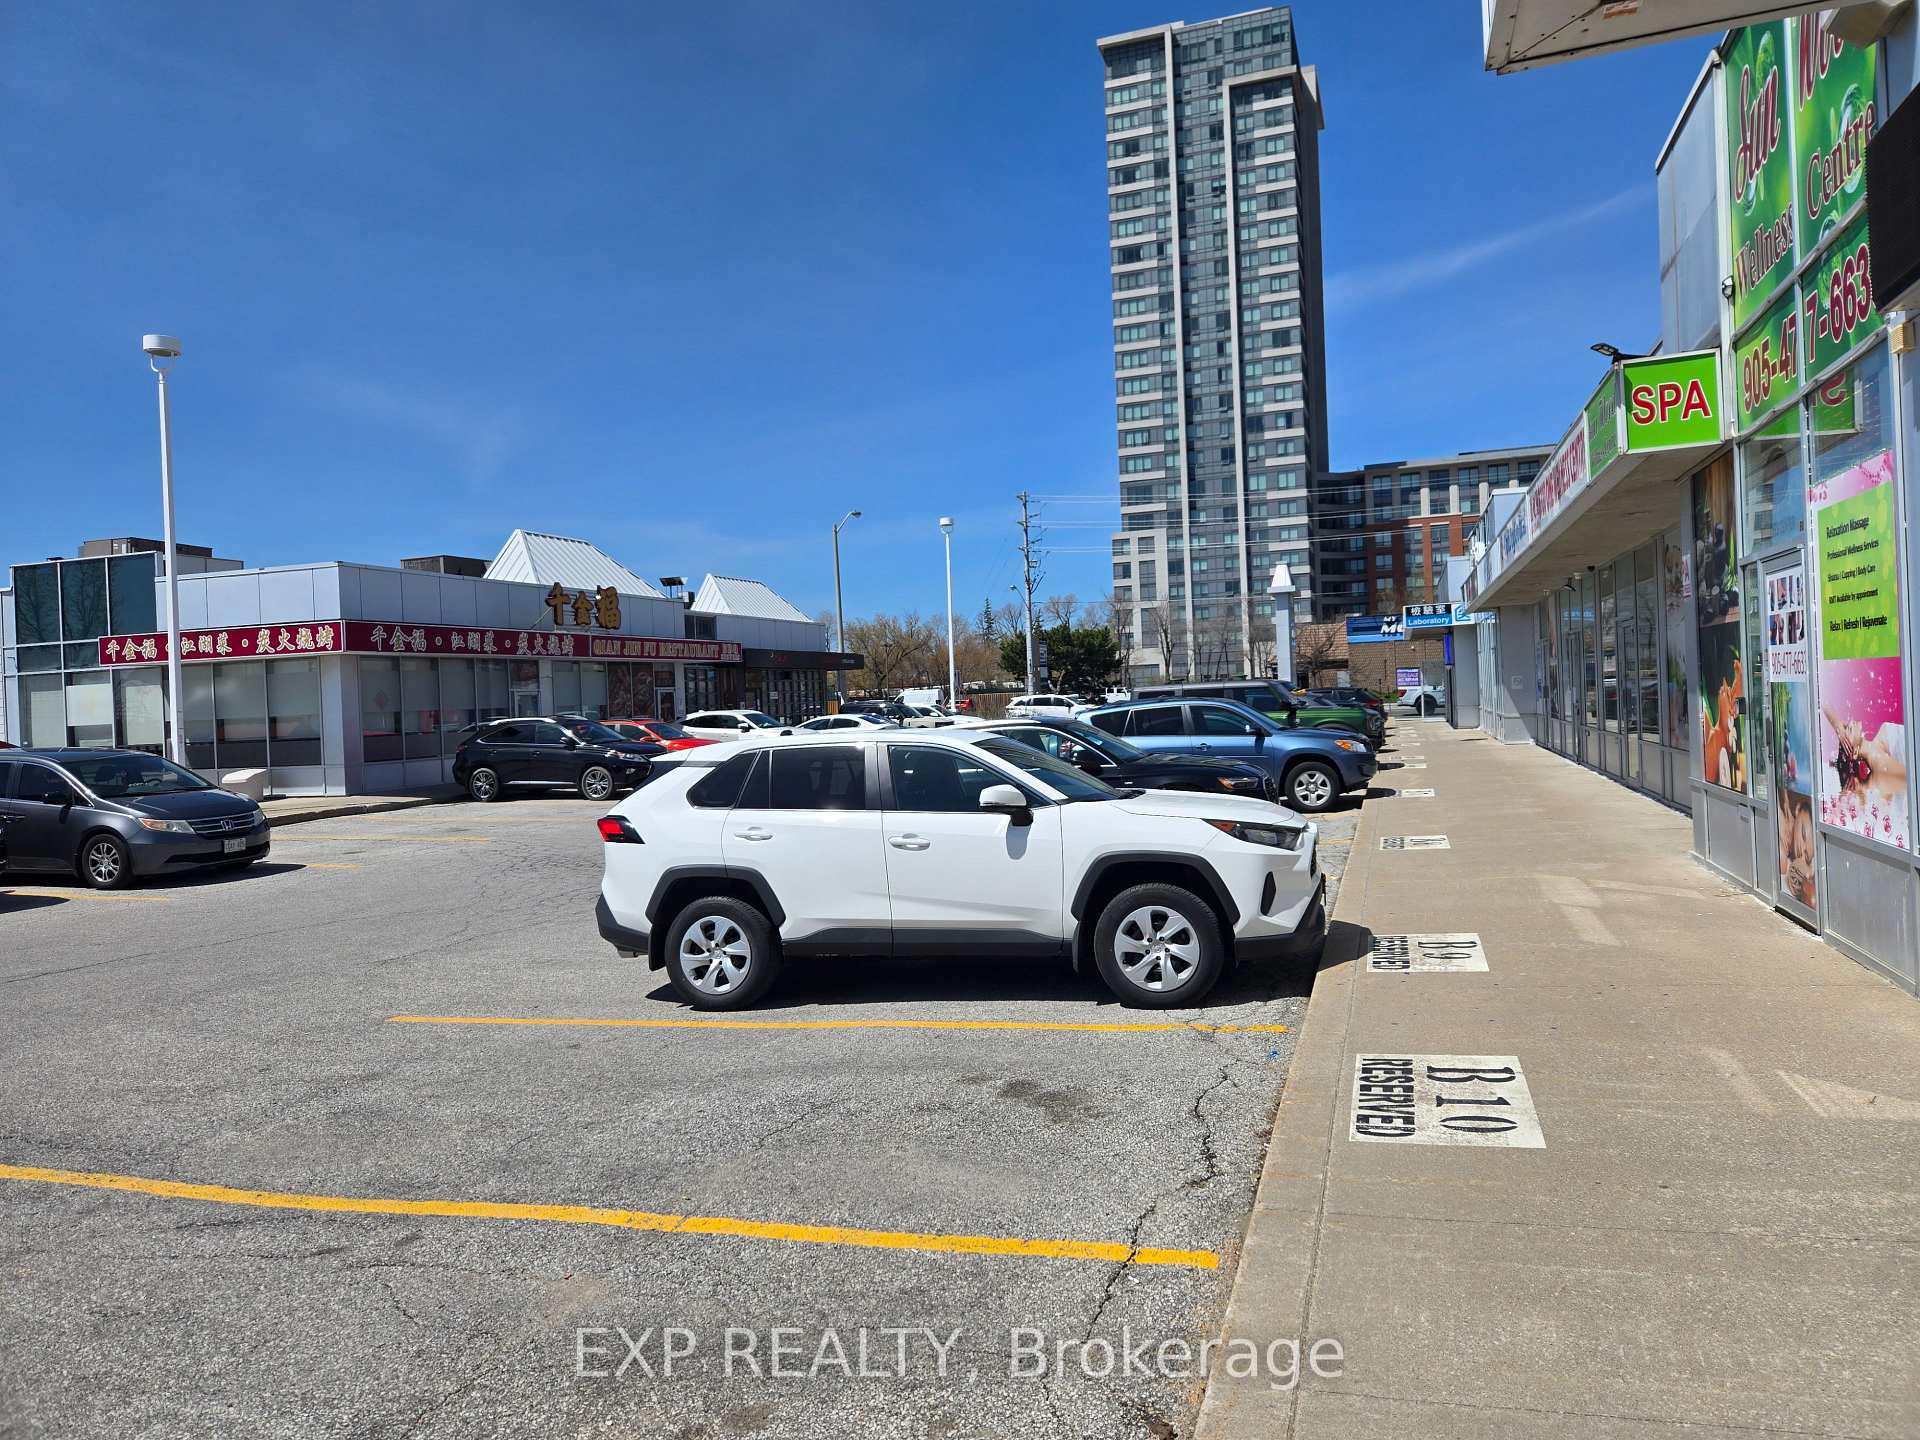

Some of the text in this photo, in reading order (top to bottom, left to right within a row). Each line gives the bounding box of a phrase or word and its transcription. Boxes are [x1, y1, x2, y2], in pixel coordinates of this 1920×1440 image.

[1735, 64, 1781, 203] Sun
[1735, 202, 1794, 304] Wellness
[1807, 101, 1877, 219] Centre
[1744, 243, 1873, 414] 905-477-663
[1632, 379, 1712, 425] SPA
[545, 582, 622, 630] 千金福
[1408, 616, 1450, 626] Laboratory
[105, 638, 158, 662] 千金福
[370, 625, 427, 652] 千金福
[623, 640, 641, 656] JIN
[643, 641, 657, 657] FU
[1355, 1057, 1417, 1138] RESERVED
